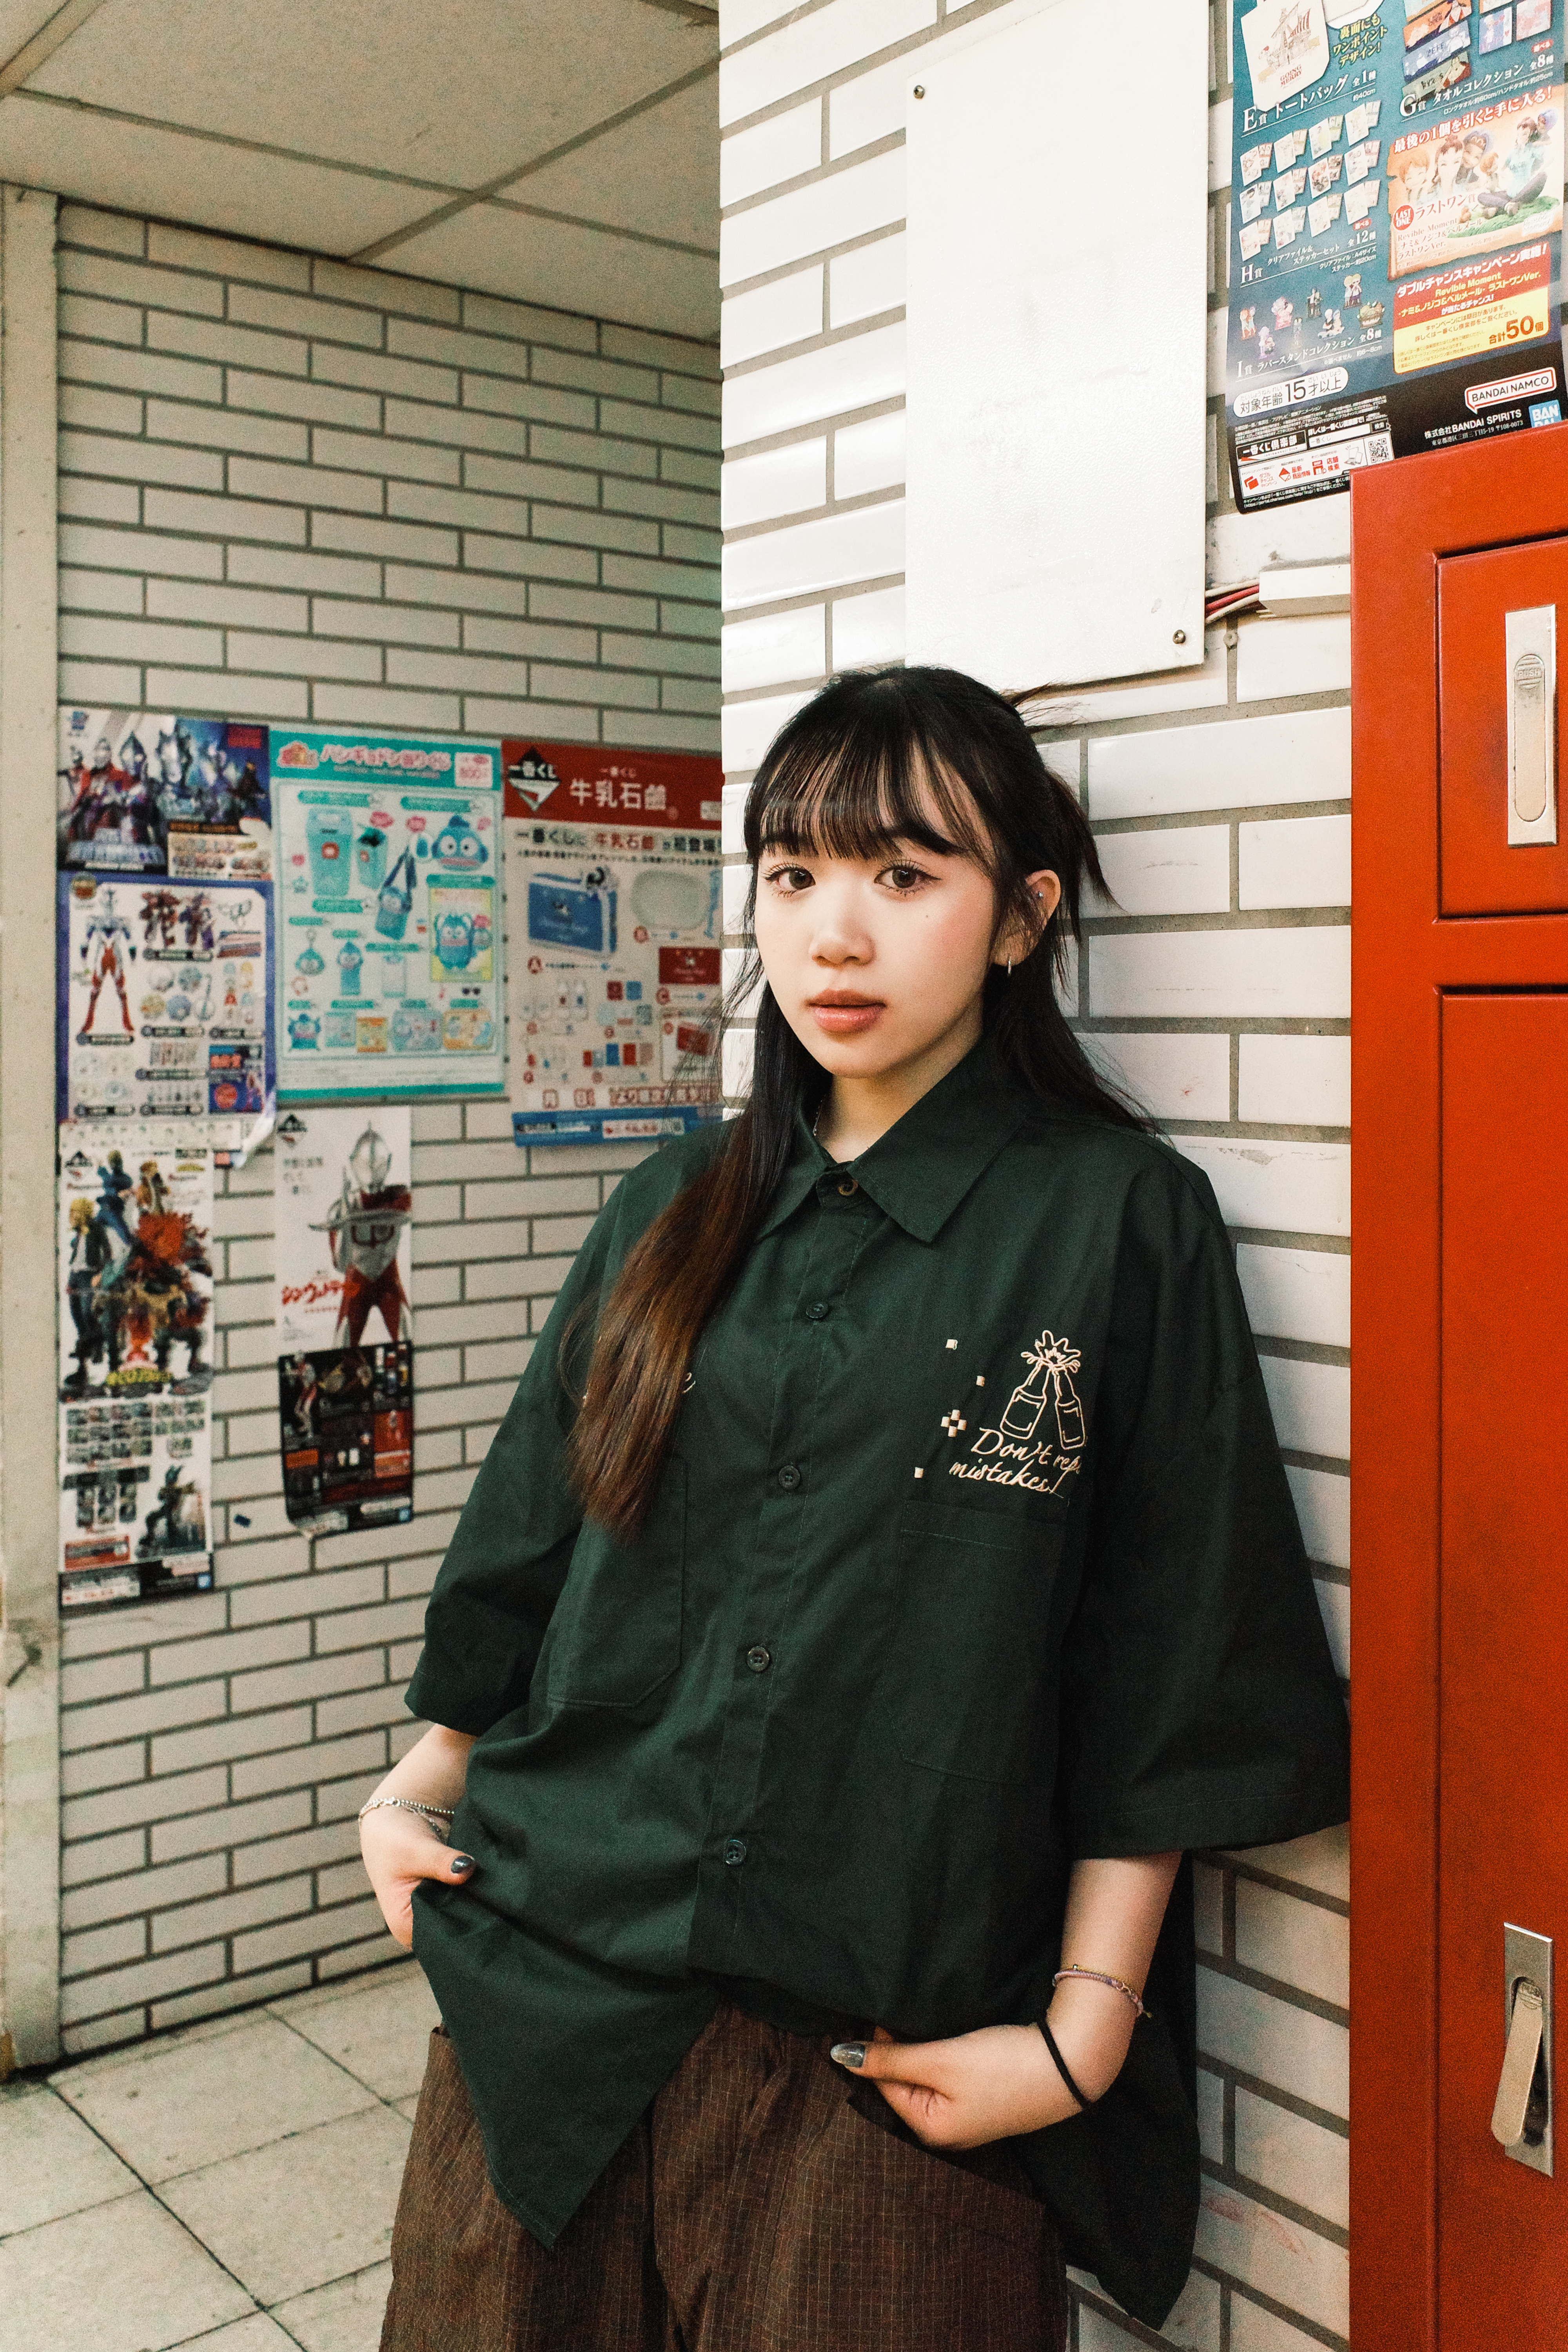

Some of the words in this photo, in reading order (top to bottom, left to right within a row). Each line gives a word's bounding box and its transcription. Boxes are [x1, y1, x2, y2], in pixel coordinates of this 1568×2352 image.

[1339, 14, 1380, 40] 裏面にも
[1333, 26, 1387, 56] ワンポイント
[1280, 64, 1302, 82] GOING
[1281, 70, 1302, 87] MERRY
[1433, 64, 1524, 106] タオルコレクション
[1276, 74, 1348, 119] トートバッグ
[1353, 89, 1376, 102] 約40cm
[1395, 208, 1411, 221] LAST
[1416, 194, 1476, 220] ラストワン賞
[1396, 216, 1410, 227] ONE
[1398, 228, 1425, 242] Revible
[1427, 218, 1457, 232] Moment
[1397, 243, 1547, 298] ダブルチャンスキャンペーン実施!
[1435, 282, 1466, 297] Revible
[1467, 272, 1501, 288] Moment
[1489, 316, 1544, 345] 合計50個
[1257, 336, 1356, 372] ラバースタンドコレクション
[1472, 387, 1509, 403] BANDAI
[1510, 376, 1549, 392] NAMCO
[1486, 409, 1522, 425] SPIRITS
[1532, 404, 1559, 422] BAN
[1310, 435, 1331, 444] 一番くじ
[1517, 668, 1541, 677] PUSH
[949, 1457, 1050, 1492] mistakes
